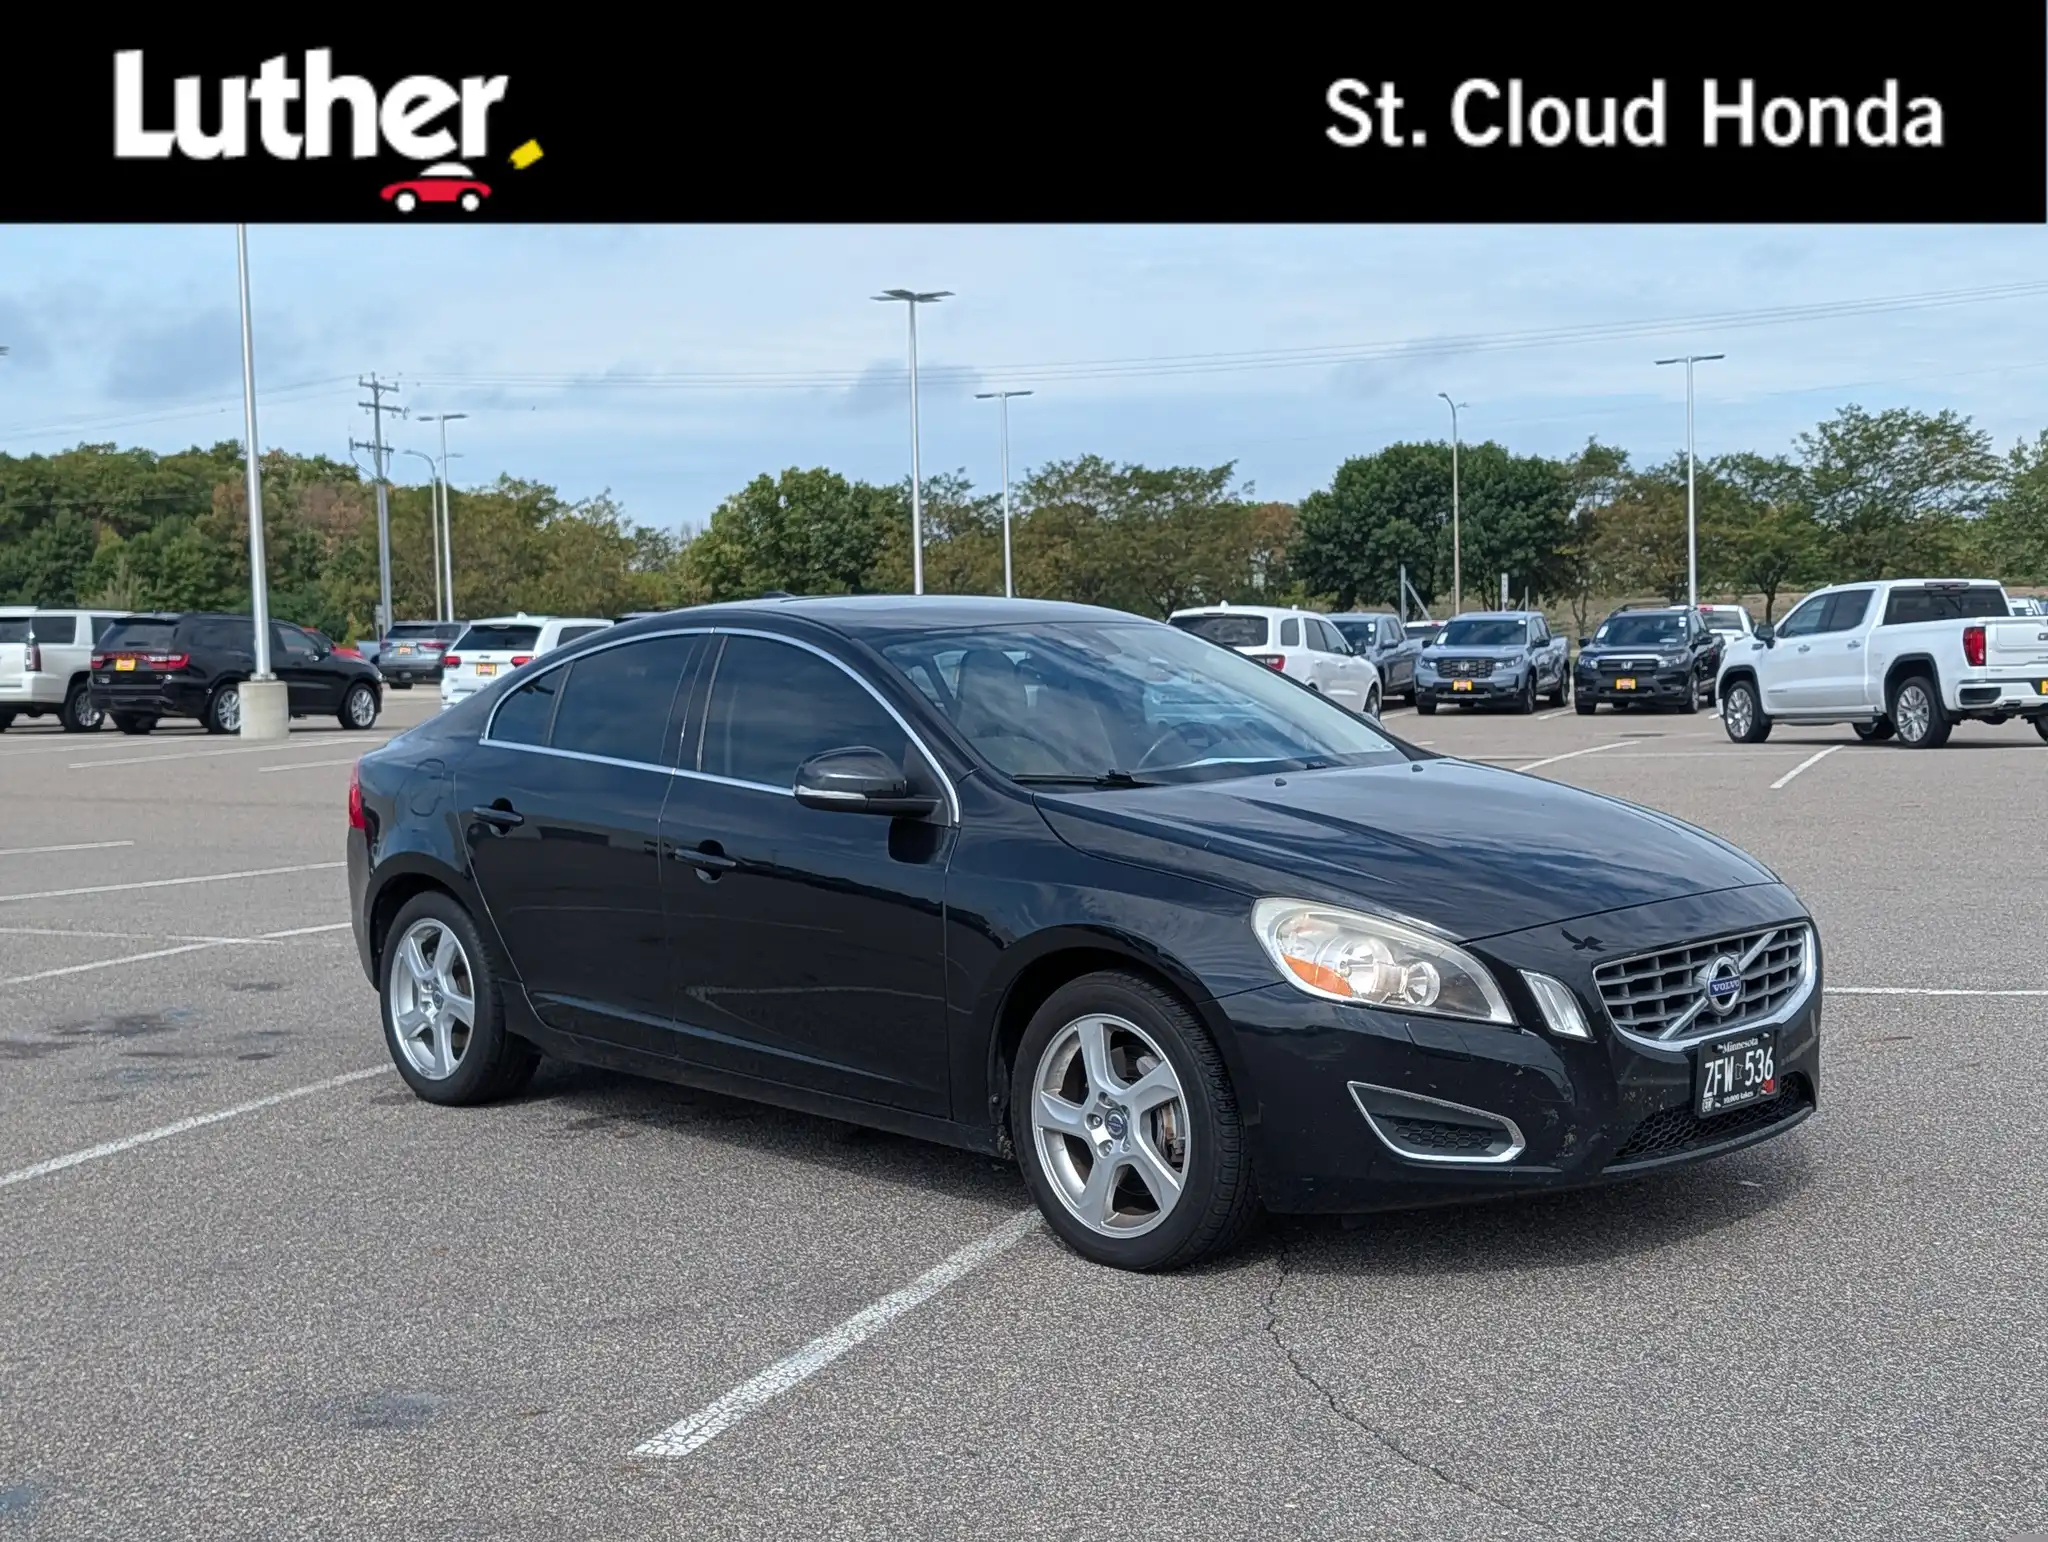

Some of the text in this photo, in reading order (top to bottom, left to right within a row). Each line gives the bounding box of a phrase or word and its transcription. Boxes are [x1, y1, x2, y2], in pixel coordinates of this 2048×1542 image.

[1712, 980, 1740, 992] VOLVO
[1722, 1038, 1758, 1053] Minnesota
[1703, 1046, 1773, 1098] ZFW 536
